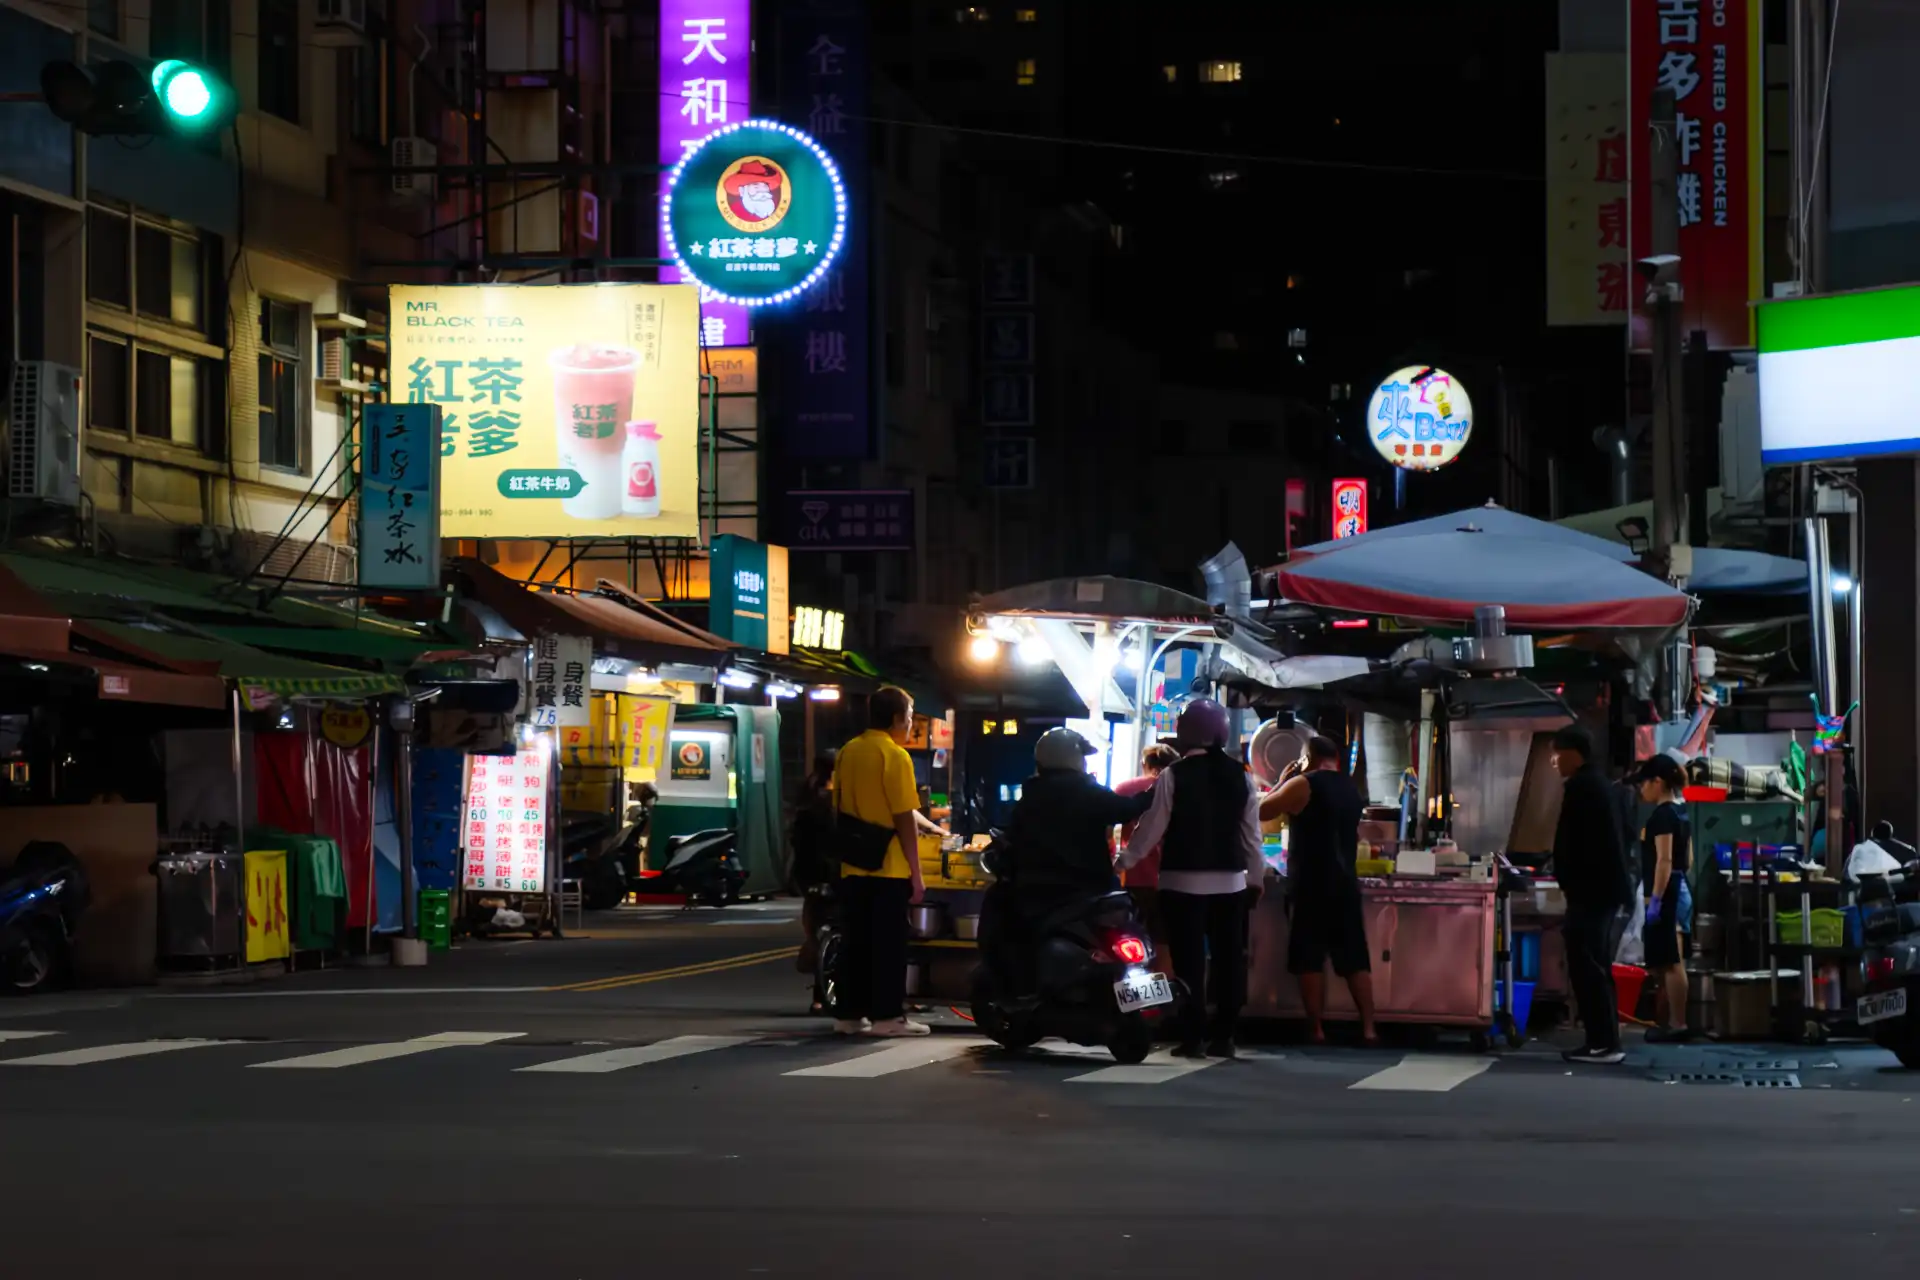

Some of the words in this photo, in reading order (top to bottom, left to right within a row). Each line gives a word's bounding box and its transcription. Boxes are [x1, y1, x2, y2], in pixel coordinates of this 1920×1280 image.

[1712, 44, 1727, 112] FRIED
[1712, 121, 1728, 227] CHICKEN
[708, 238, 799, 258] 紅茶老爹
[406, 316, 475, 327] BLACK
[485, 316, 524, 327] TEA
[407, 356, 523, 404] 紅茶
[509, 476, 571, 491] 紅茶牛奶
[535, 636, 557, 707] 健身餐
[470, 809, 487, 820] 60
[523, 810, 539, 820] 45
[520, 880, 537, 891] 60
